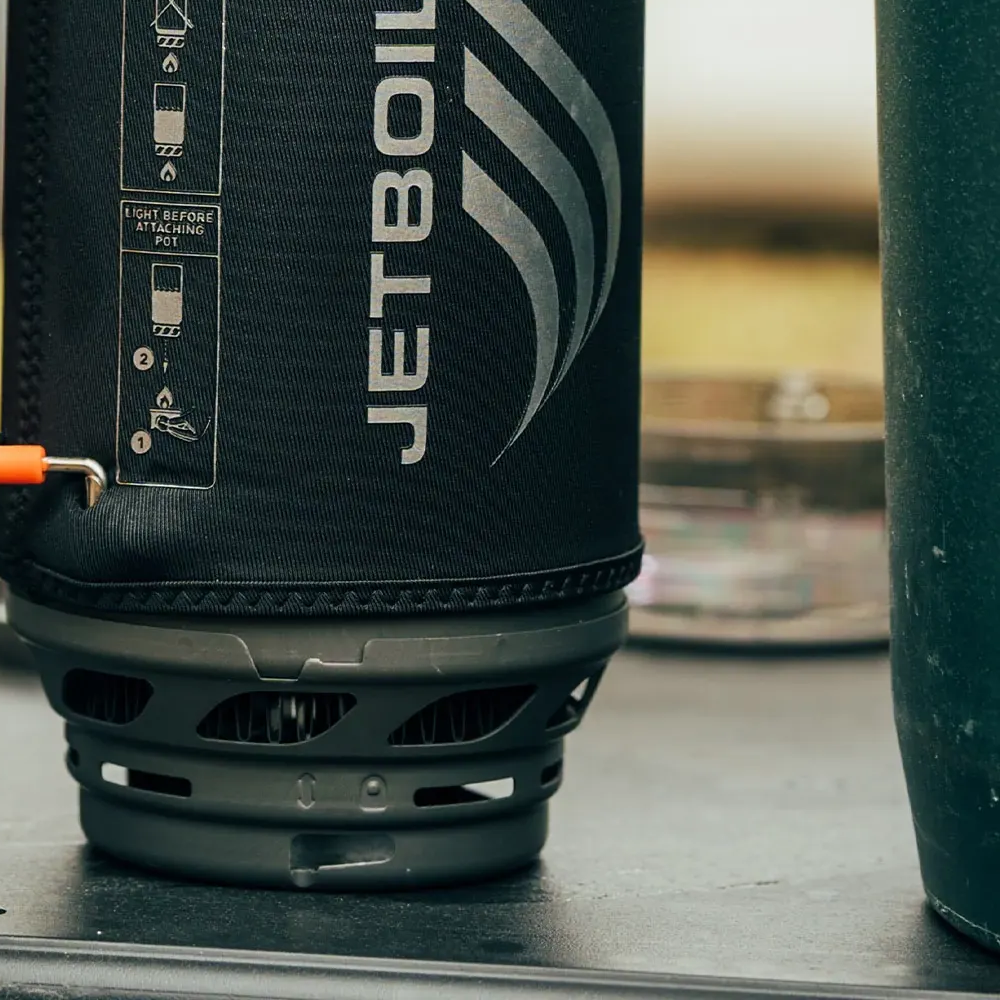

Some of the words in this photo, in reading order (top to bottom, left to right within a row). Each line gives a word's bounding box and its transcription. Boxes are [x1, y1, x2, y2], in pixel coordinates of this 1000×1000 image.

[125, 207, 159, 219] LIGHT
[163, 210, 214, 223] BEFORE
[135, 221, 205, 235] ATTACHING
[155, 235, 178, 247] POT
